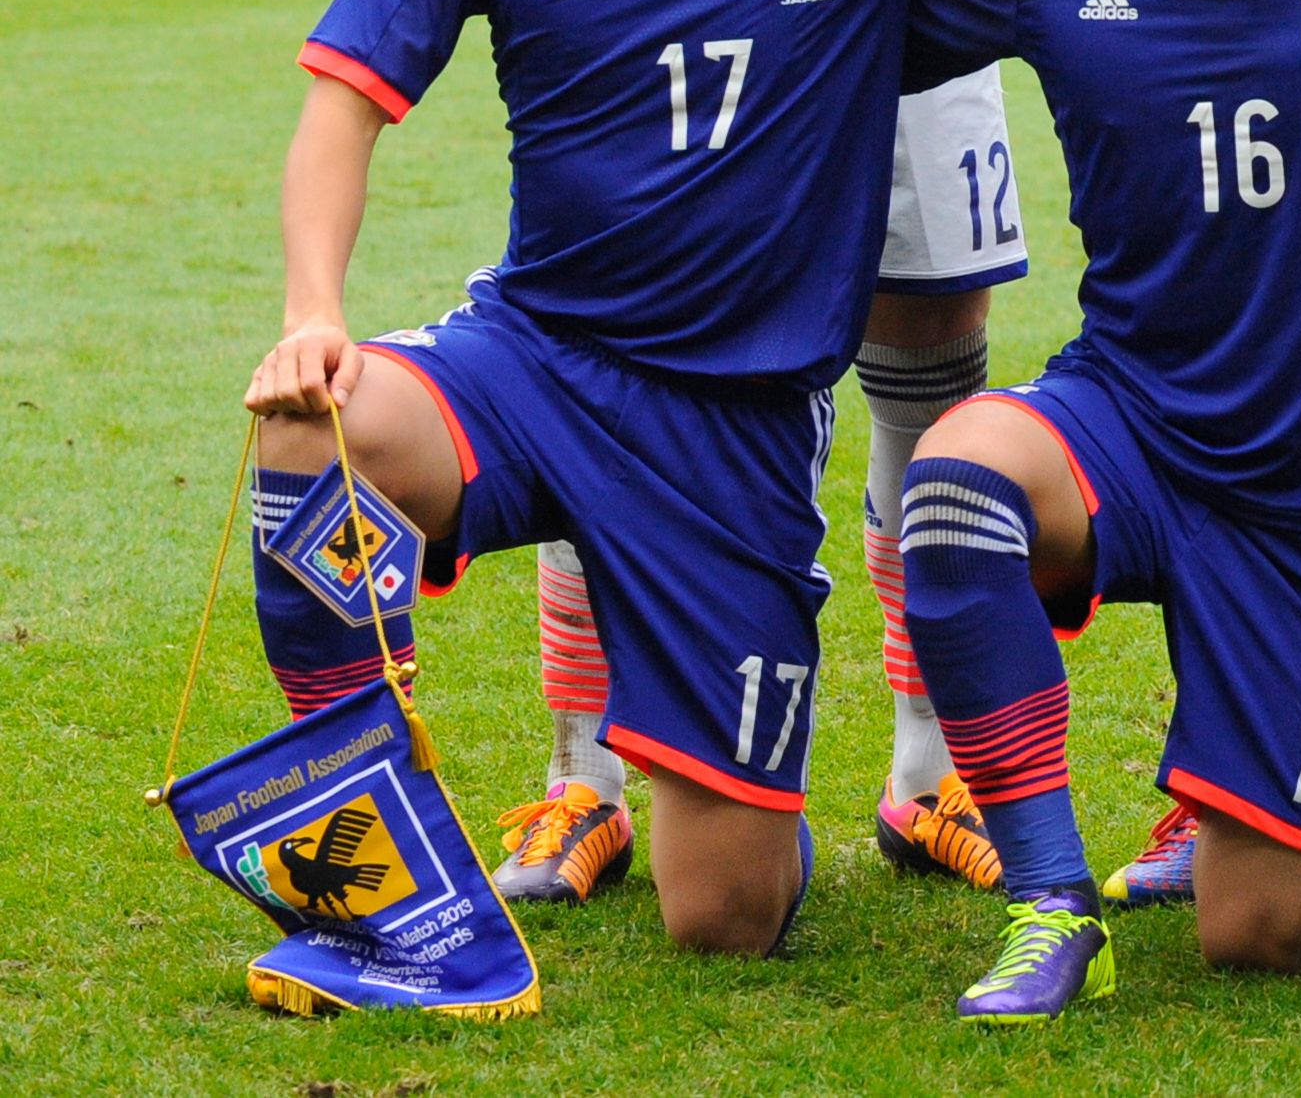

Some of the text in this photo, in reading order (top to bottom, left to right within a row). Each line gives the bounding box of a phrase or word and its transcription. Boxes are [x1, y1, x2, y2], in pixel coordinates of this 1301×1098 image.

[1078, 4, 1139, 21] adidas
[656, 38, 754, 151] 17
[958, 140, 1018, 252] 12
[1186, 98, 1286, 213] 16
[735, 655, 810, 772] 17
[193, 722, 395, 836] Japan Football Association
[395, 920, 439, 950] Match
[437, 898, 475, 928] 2013
